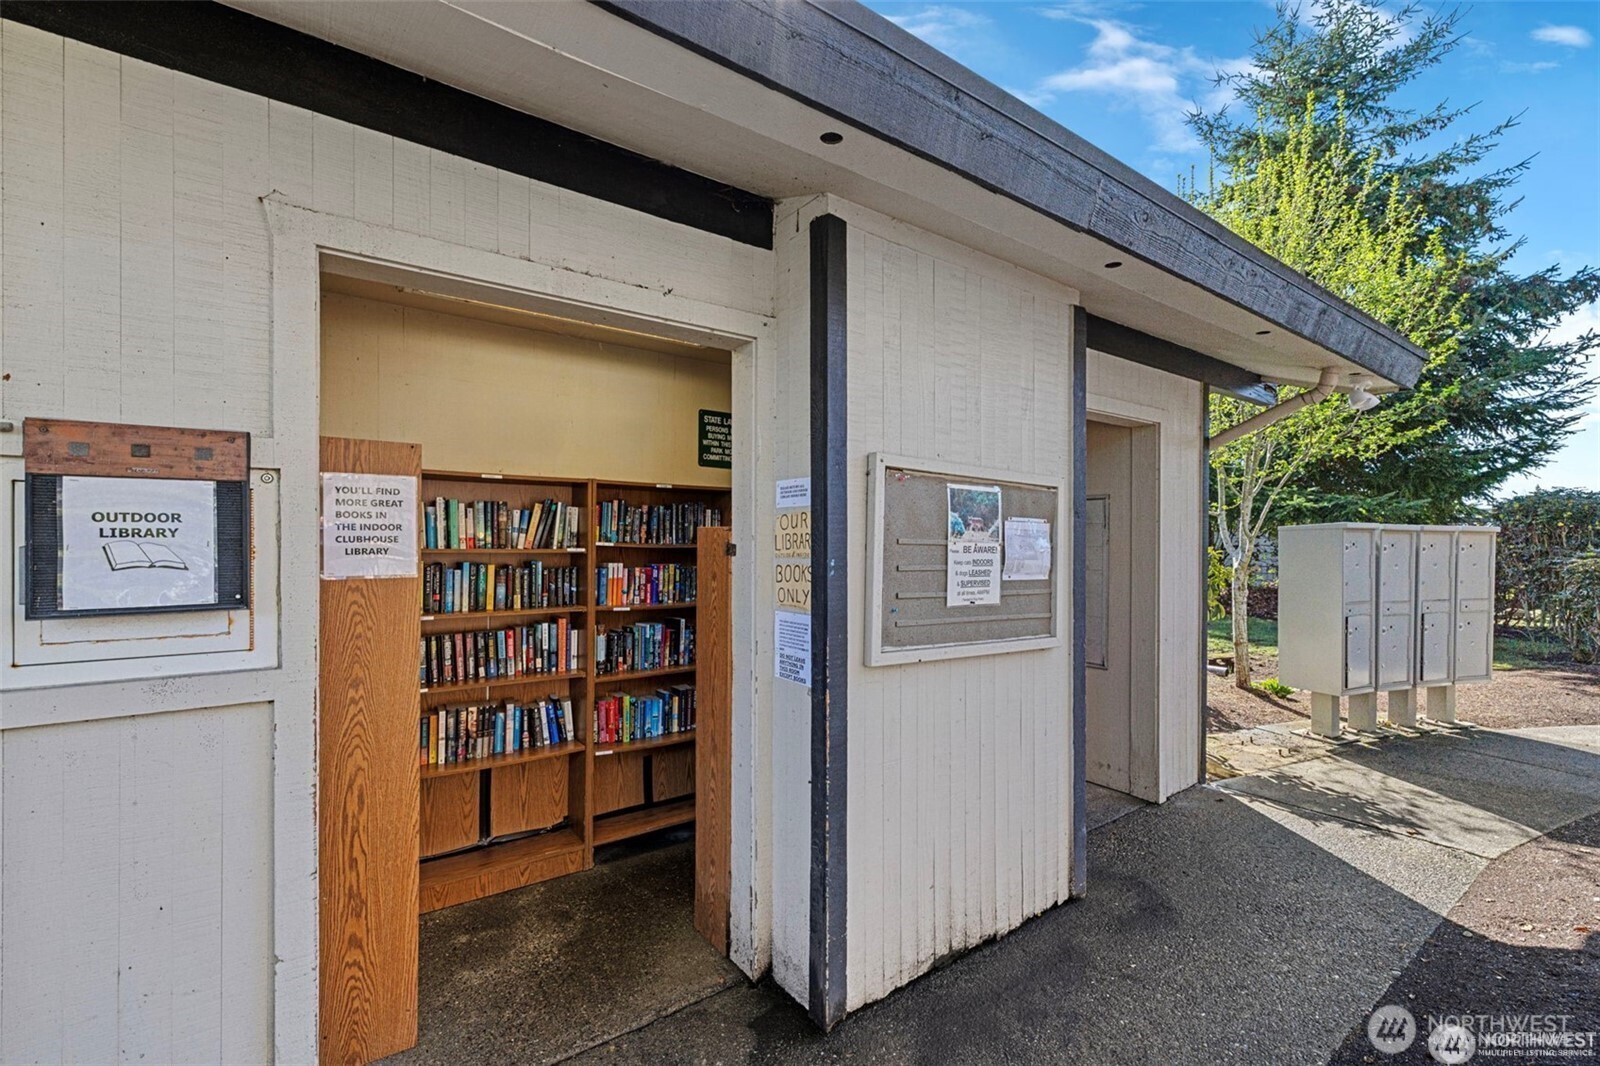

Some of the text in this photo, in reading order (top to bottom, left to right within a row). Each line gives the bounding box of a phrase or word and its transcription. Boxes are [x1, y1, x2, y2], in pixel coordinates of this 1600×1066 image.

[704, 415, 722, 424] STATE
[706, 425, 729, 433] PERSONS
[707, 432, 726, 440] BUYING
[703, 439, 720, 447] WITHIN
[335, 486, 401, 496] YOU'LL FIND
[335, 498, 404, 508] MORE GREAT
[91, 511, 183, 523] OUTDOOR
[335, 511, 373, 519] BOOKS
[780, 511, 809, 530] OUR
[335, 523, 403, 531] THE INDOOR
[99, 527, 179, 539] LIBRARY
[335, 535, 399, 544] CLUBHOUSE
[775, 532, 811, 552] LIBRAR
[345, 547, 390, 556] LIBRARY
[963, 546, 972, 554] BE
[775, 564, 812, 583] BOOKS
[960, 580, 991, 588] SUPERVISED
[777, 586, 810, 606] ONLY
